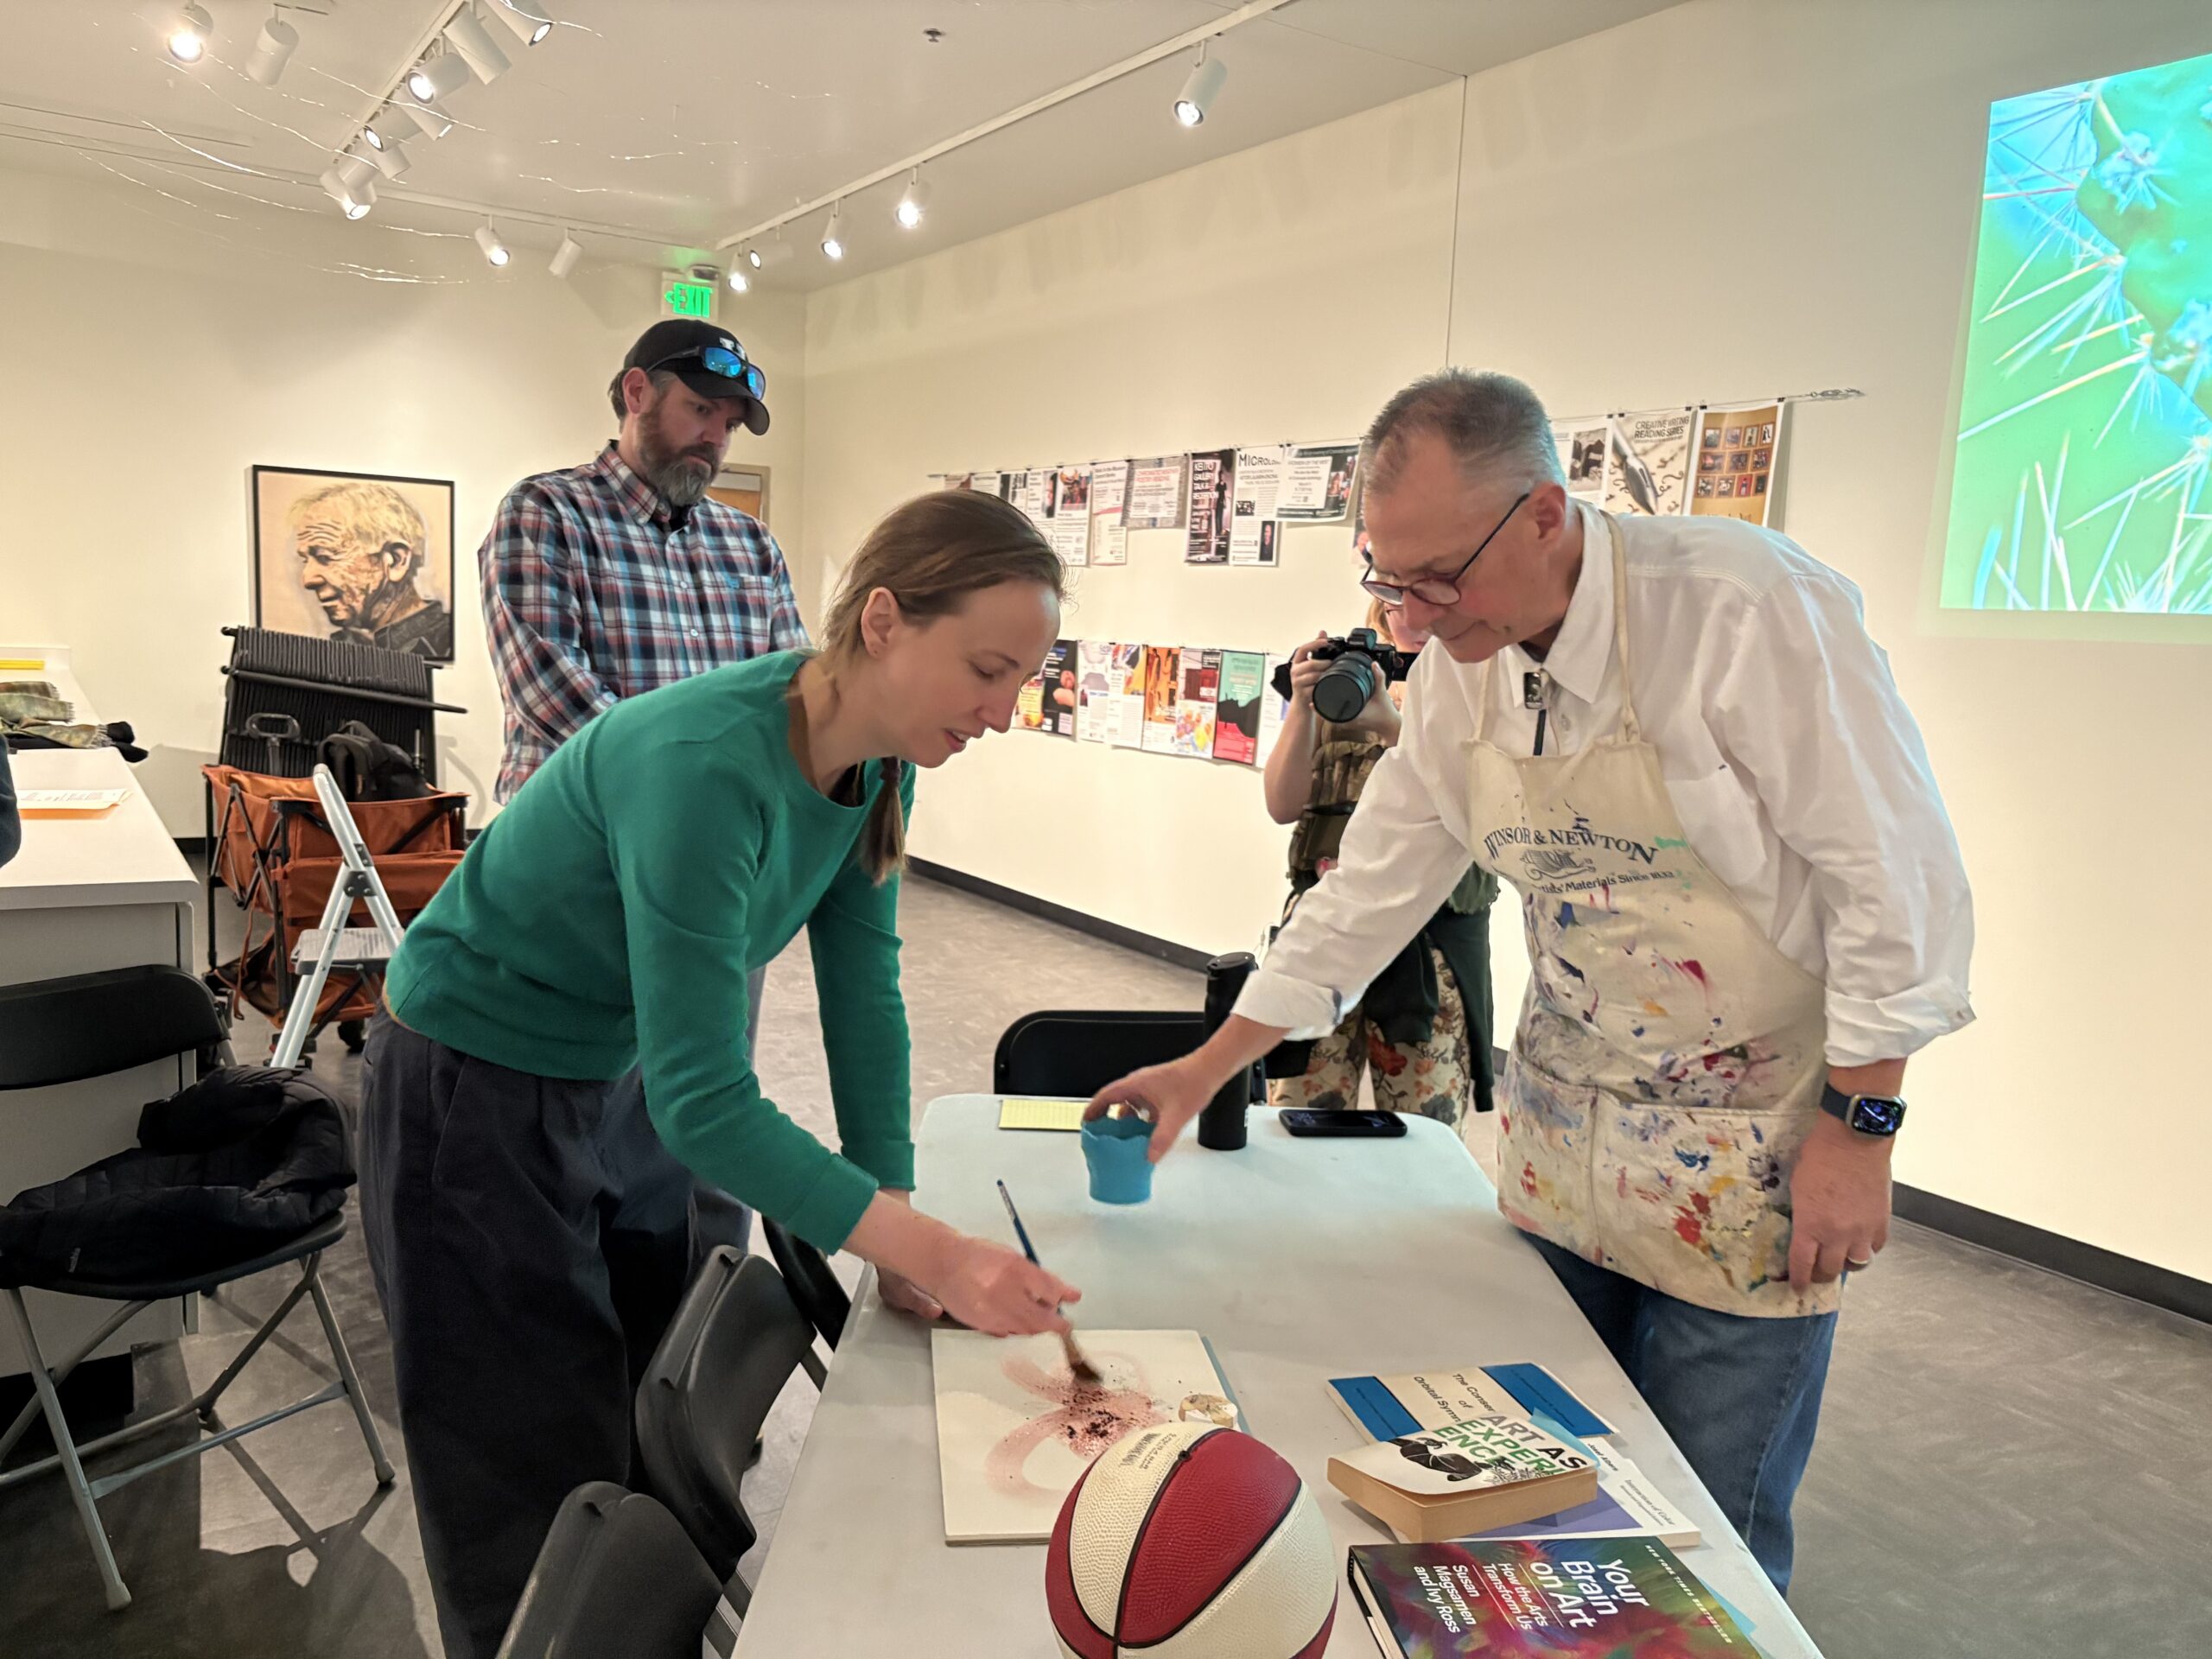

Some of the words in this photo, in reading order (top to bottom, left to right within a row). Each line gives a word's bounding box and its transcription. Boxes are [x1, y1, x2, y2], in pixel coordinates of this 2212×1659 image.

[672, 283, 713, 318] EXIT
[1634, 429, 1666, 439] READING
[1666, 426, 1684, 437] SERIES
[1635, 419, 1667, 430] CREATIVE
[1668, 416, 1690, 427] WRITING
[1484, 826, 1532, 861] WINSOR
[1534, 830, 1548, 845] &
[1548, 829, 1659, 865] NEWTON
[1565, 875, 1618, 893] Materials
[1617, 873, 1650, 884] Since
[1414, 1376, 1443, 1399] Orbital
[1452, 1373, 1469, 1386] The
[1466, 1386, 1496, 1412] Conser
[1458, 1400, 1474, 1409] of
[1456, 1419, 1567, 1475] EXPERI
[1478, 1414, 1547, 1443] ART
[1535, 1446, 1588, 1470] AS
[1624, 1479, 1652, 1506] Interaction
[1658, 1510, 1675, 1525] Color
[1414, 1566, 1433, 1586] and
[1433, 1565, 1477, 1625] Magsamen
[1452, 1564, 1480, 1598] Susan
[1497, 1562, 1520, 1586] How
[1514, 1586, 1532, 1604] the
[1527, 1605, 1548, 1627] Arts
[1529, 1561, 1563, 1588] on
[1548, 1592, 1597, 1629] Art
[1560, 1560, 1618, 1616] Brain
[1596, 1559, 1650, 1607] Your
[1645, 1544, 1661, 1558] NEW
[1658, 1558, 1676, 1575] YORK
[1674, 1575, 1695, 1597] TIMES
[1692, 1599, 1732, 1643] BESTSELLER
[1427, 1586, 1445, 1607] Ivy
[1483, 1563, 1520, 1618] Transform
[1515, 1615, 1533, 1630] Us
[1435, 1605, 1461, 1633] Ross
